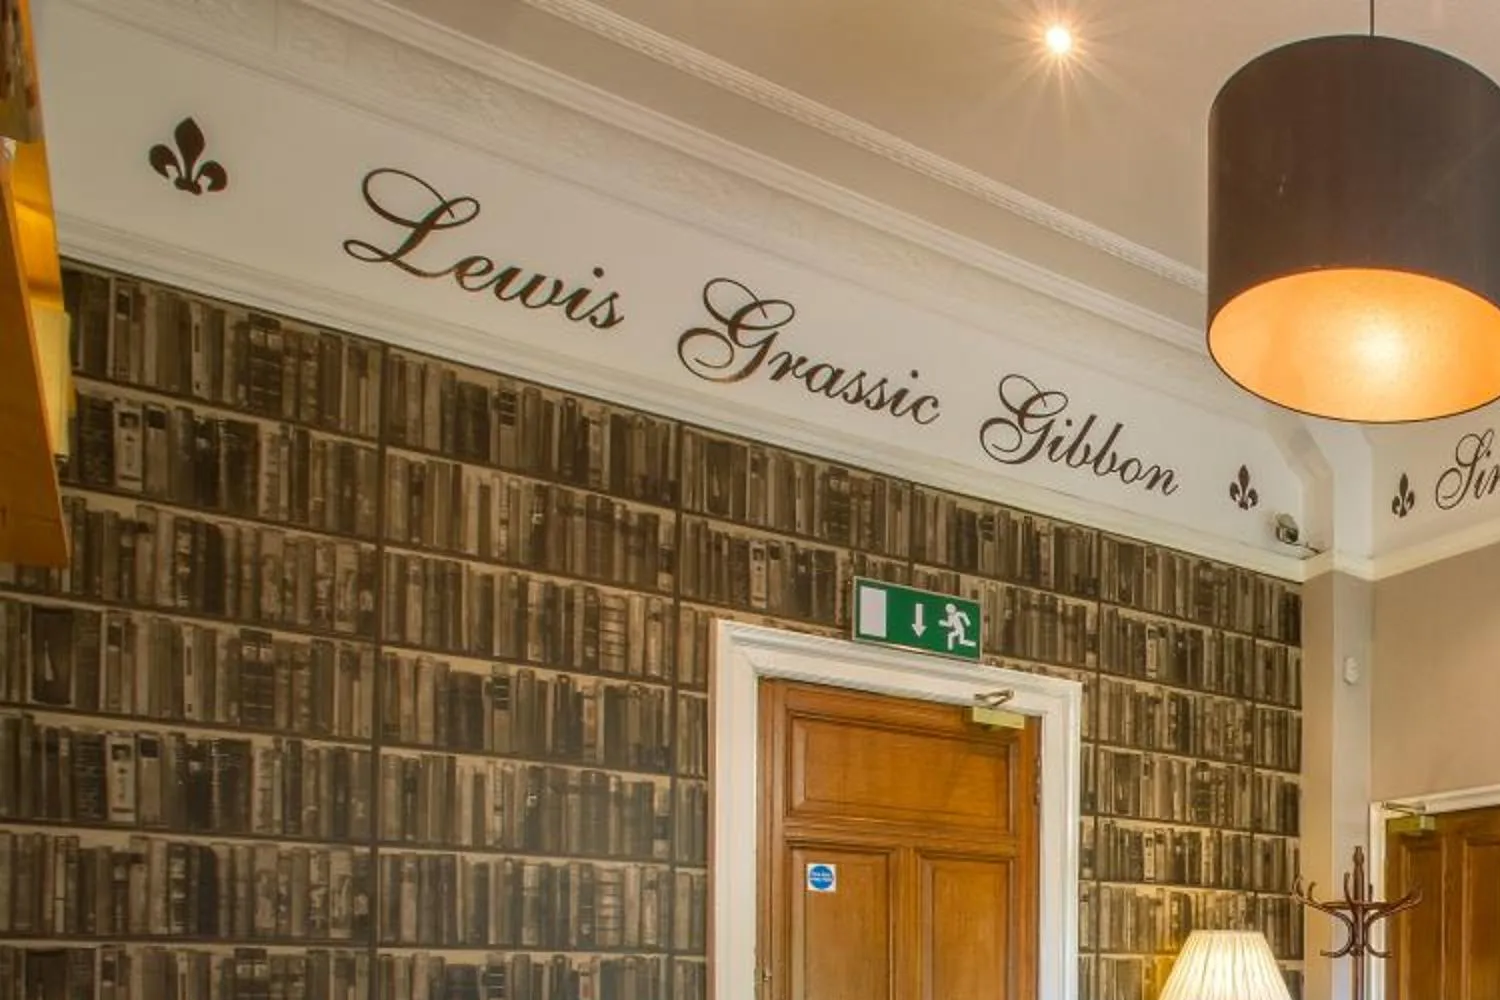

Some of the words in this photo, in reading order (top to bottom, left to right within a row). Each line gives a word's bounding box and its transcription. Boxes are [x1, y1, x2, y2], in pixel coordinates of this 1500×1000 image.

[343, 168, 624, 329] Lewis
[677, 278, 940, 425] Grassic
[979, 374, 1179, 496] Gibbon
